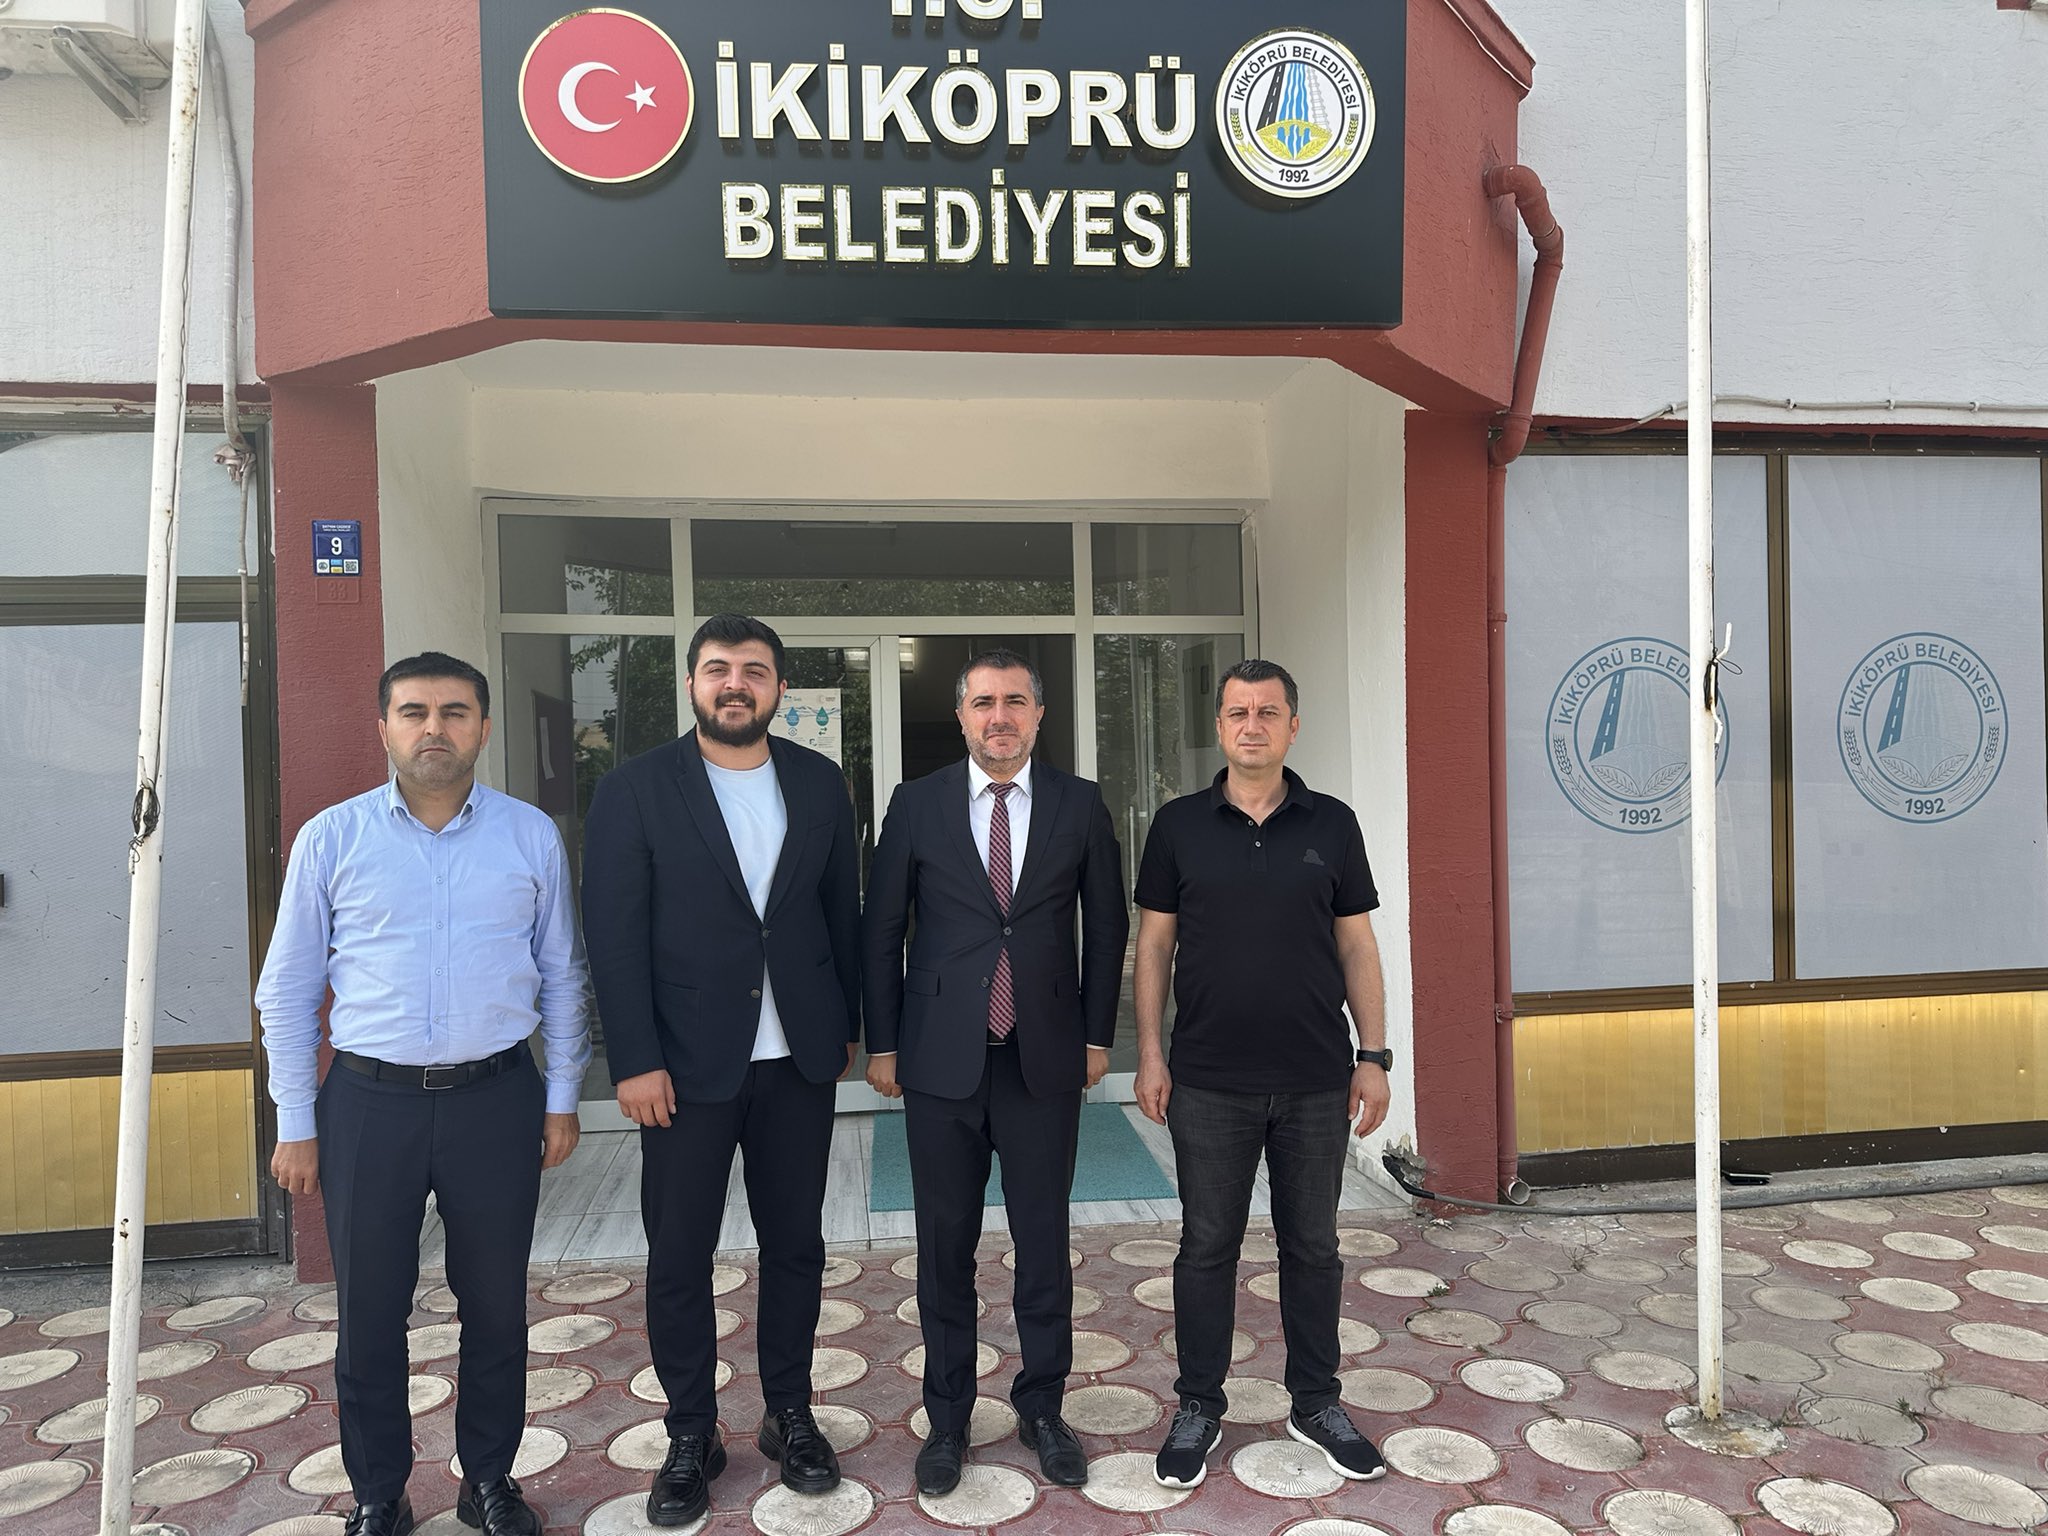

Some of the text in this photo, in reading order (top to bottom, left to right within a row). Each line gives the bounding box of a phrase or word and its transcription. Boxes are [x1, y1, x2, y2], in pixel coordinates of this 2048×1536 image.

[716, 41, 1196, 149] İKİKÖPRÜ
[1231, 44, 1360, 109] İKİKÖPRÜ BELEDİYESİ
[1278, 168, 1310, 183] 1992
[721, 168, 1191, 268] BELEDİYESİ
[331, 537, 342, 555] 9
[1554, 648, 1690, 725] İKİKÖPRÜ BELED
[1845, 642, 2000, 717] İKİKÖPRÜ BELEDİYESİ
[1619, 807, 1663, 825] 1992
[1905, 798, 1945, 815] 1992
